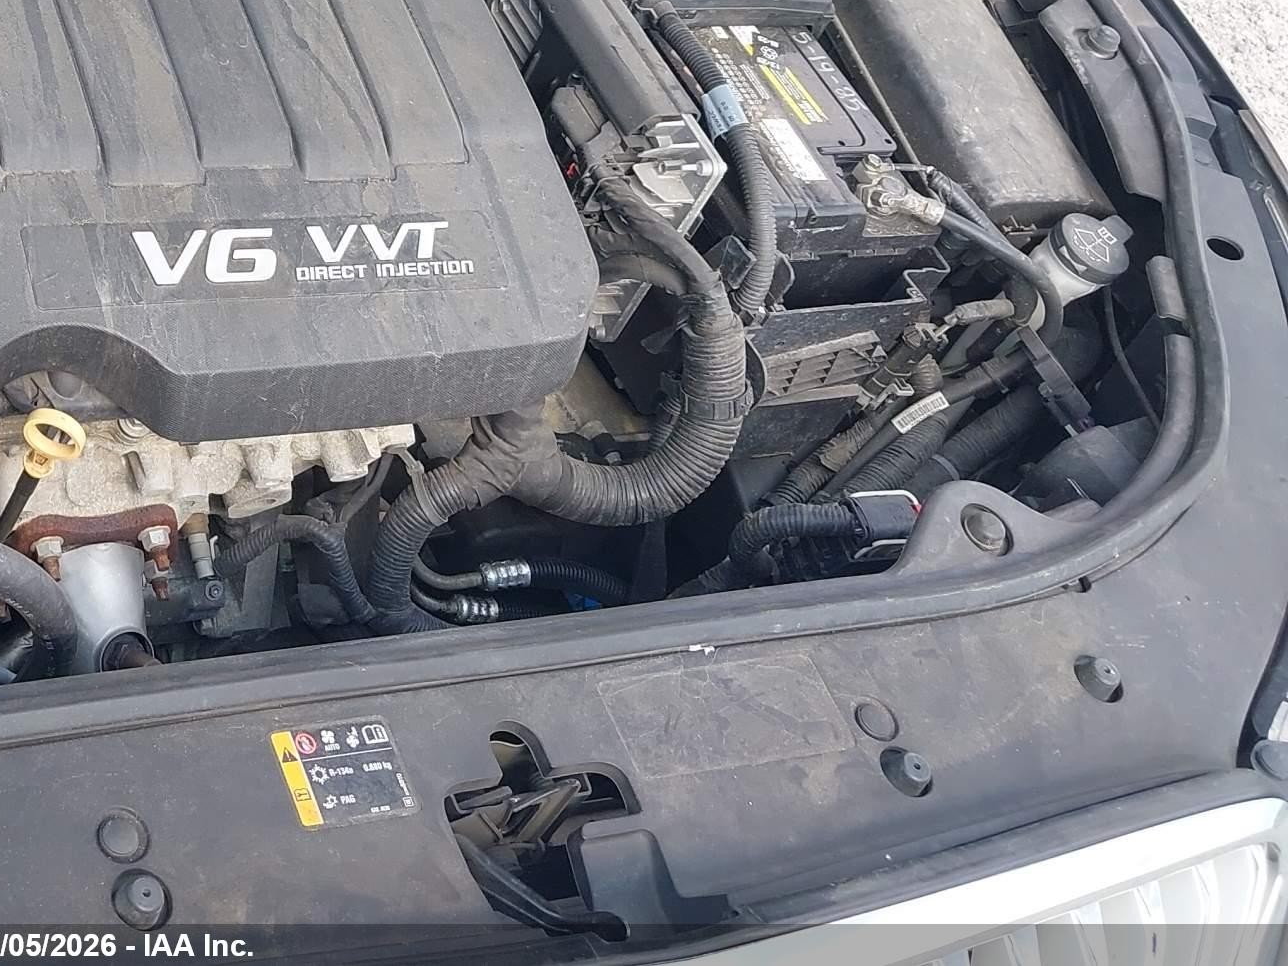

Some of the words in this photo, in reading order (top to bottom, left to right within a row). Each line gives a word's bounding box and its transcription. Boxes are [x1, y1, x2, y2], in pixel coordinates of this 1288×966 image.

[131, 227, 278, 286] V6
[305, 221, 449, 263] VVT
[295, 264, 368, 282] DIRECT
[376, 260, 474, 279] INJECTION
[340, 794, 356, 804] PAG
